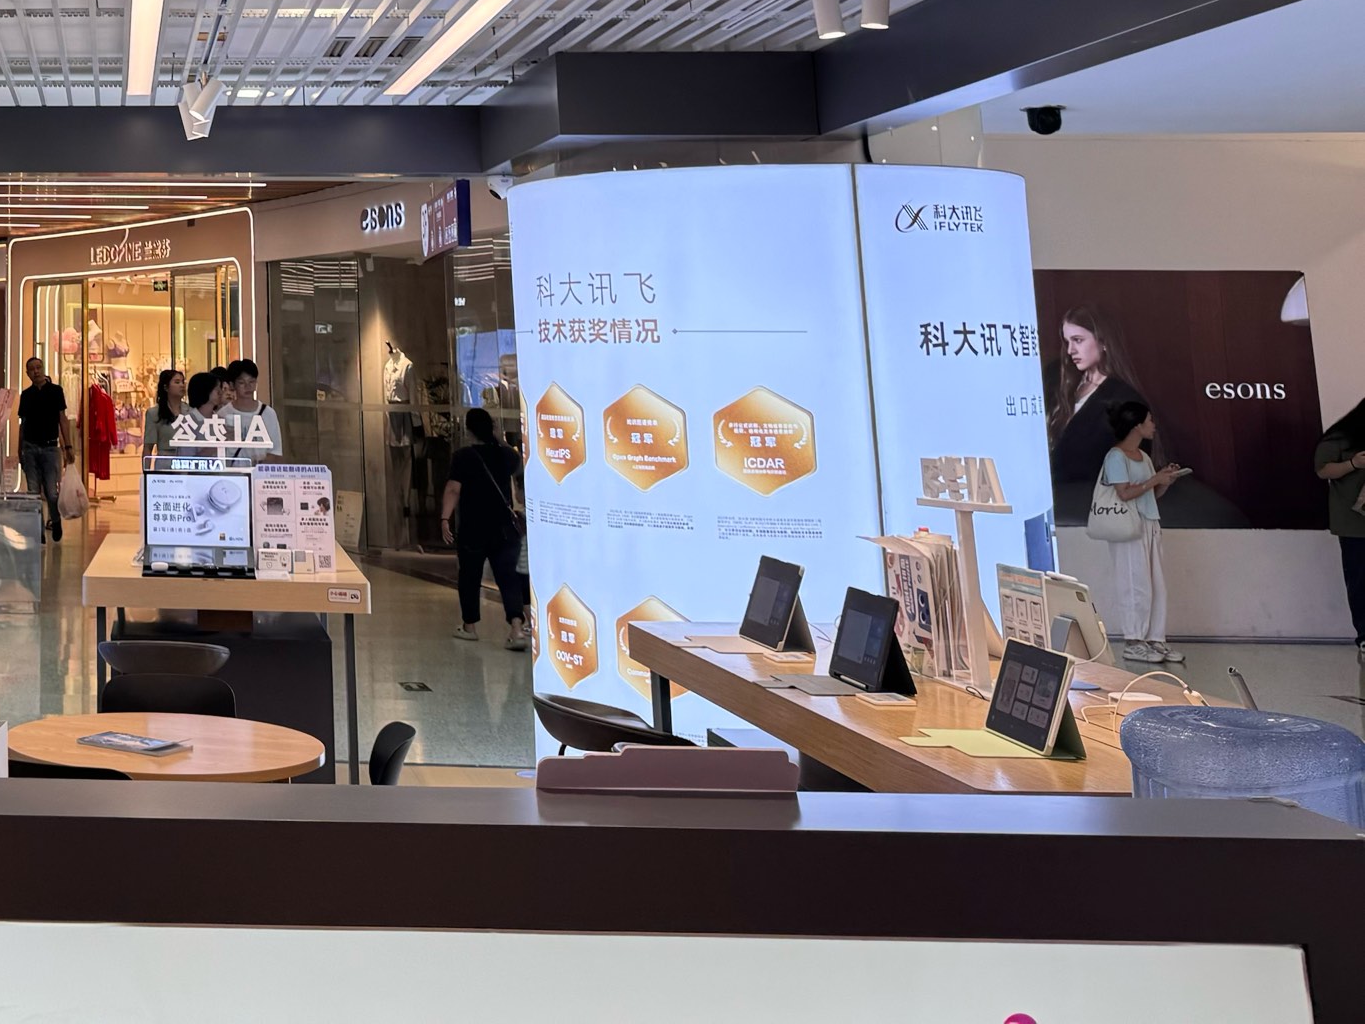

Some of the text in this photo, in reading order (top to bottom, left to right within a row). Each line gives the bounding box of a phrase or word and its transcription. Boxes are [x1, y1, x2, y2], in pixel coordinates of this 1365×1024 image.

[360, 202, 405, 233] esons
[933, 204, 983, 221] 科大讯飞
[934, 221, 984, 233] iFLYTEK
[536, 272, 656, 307] 科大讯飞
[538, 318, 661, 344] 技术获奖情况
[1205, 381, 1286, 400] esons
[744, 457, 785, 469] ICDAR
